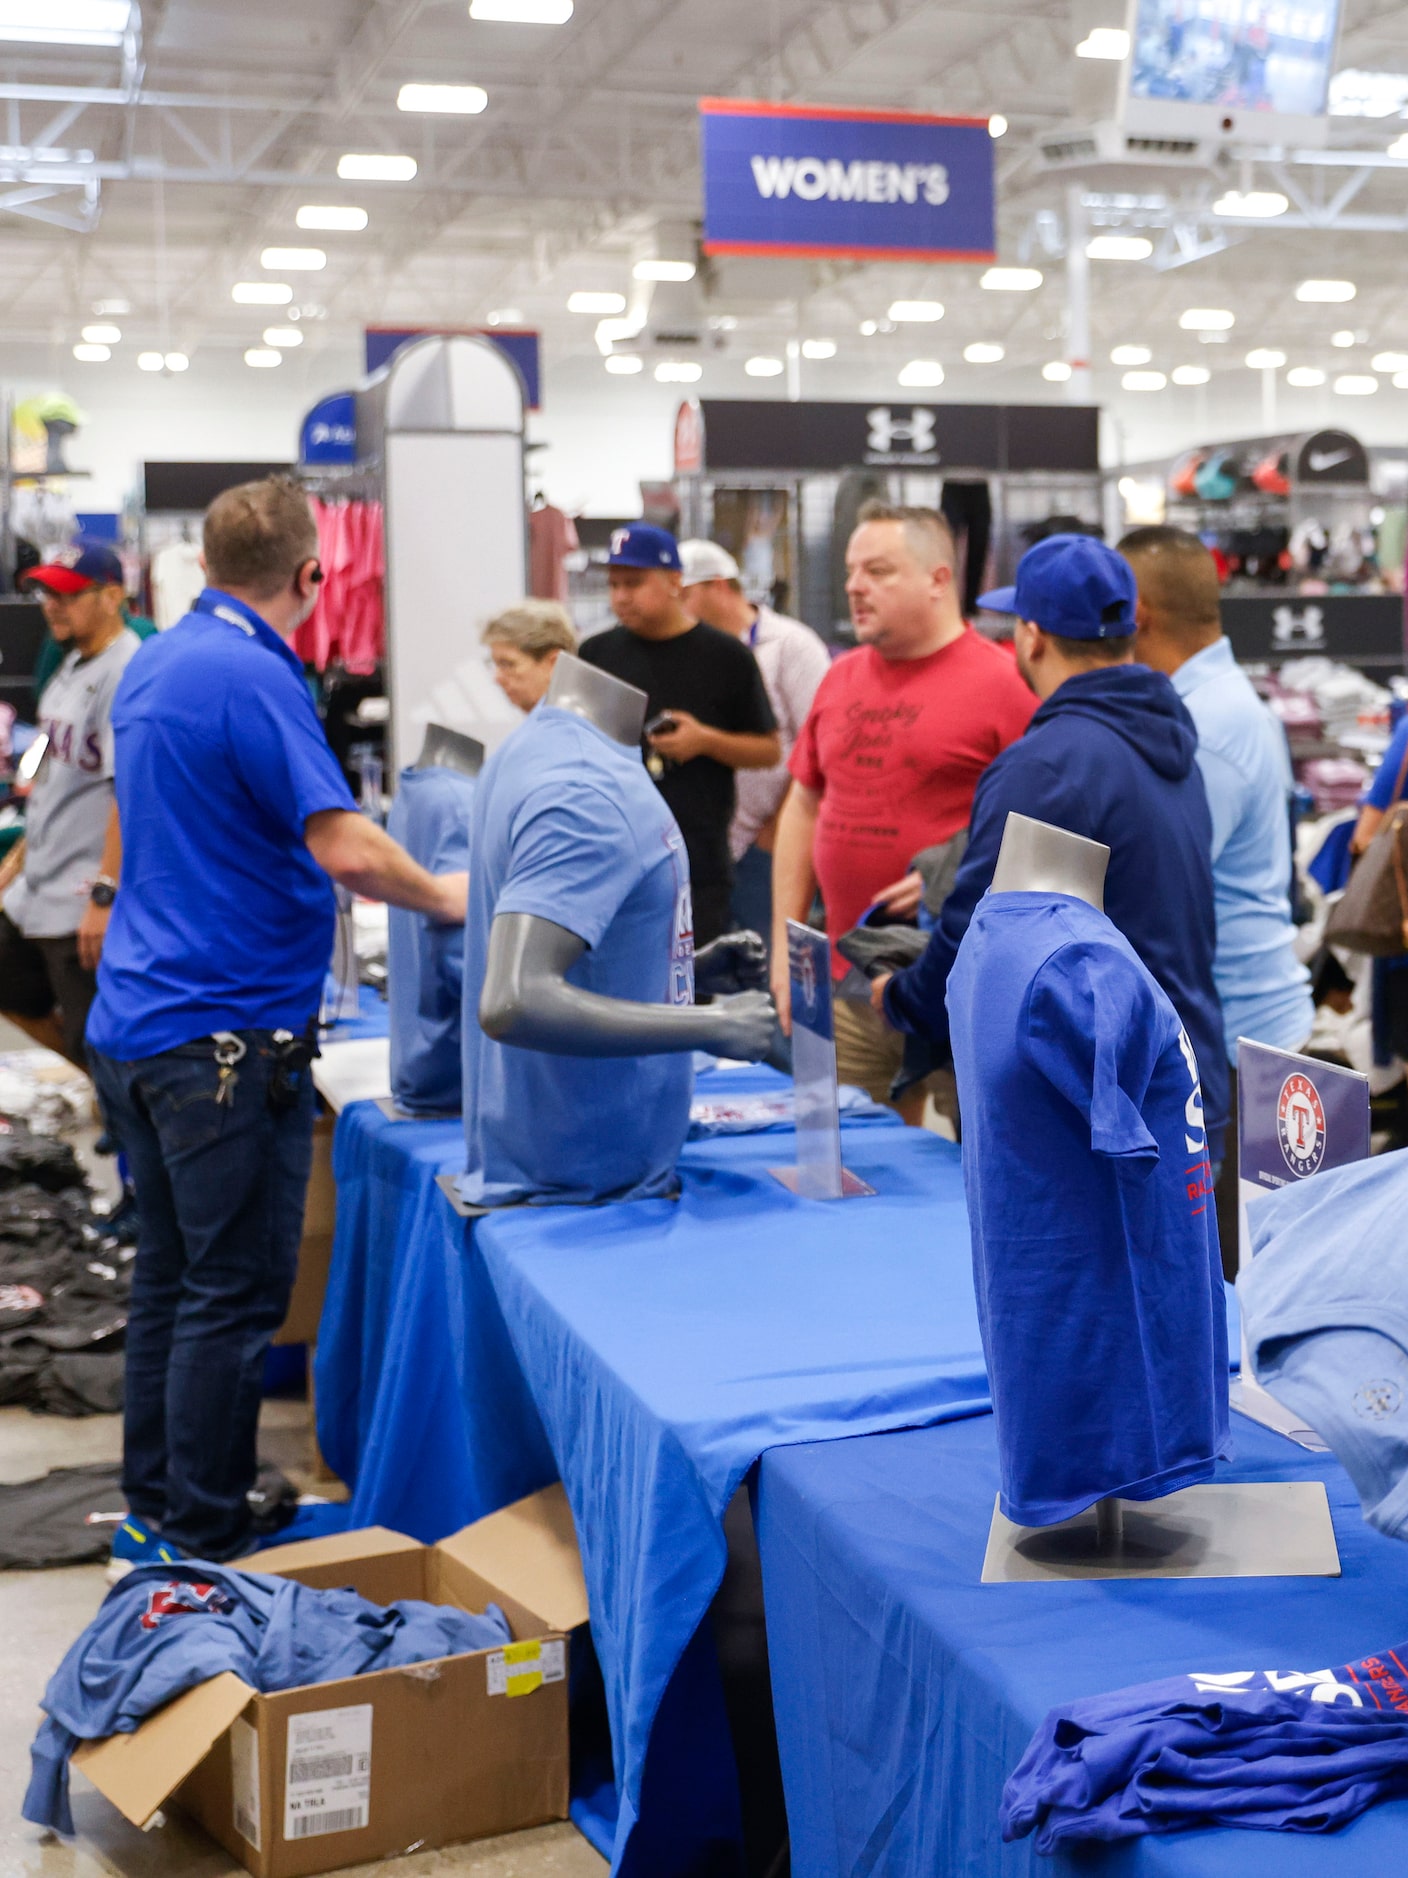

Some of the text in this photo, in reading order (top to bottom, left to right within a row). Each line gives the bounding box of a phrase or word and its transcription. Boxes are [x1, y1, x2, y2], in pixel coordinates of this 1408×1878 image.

[751, 155, 950, 206] WOMEN'S
[1284, 1079, 1319, 1109] TEXAS
[1280, 1127, 1322, 1172] RANGERS
[1292, 1104, 1310, 1150] T
